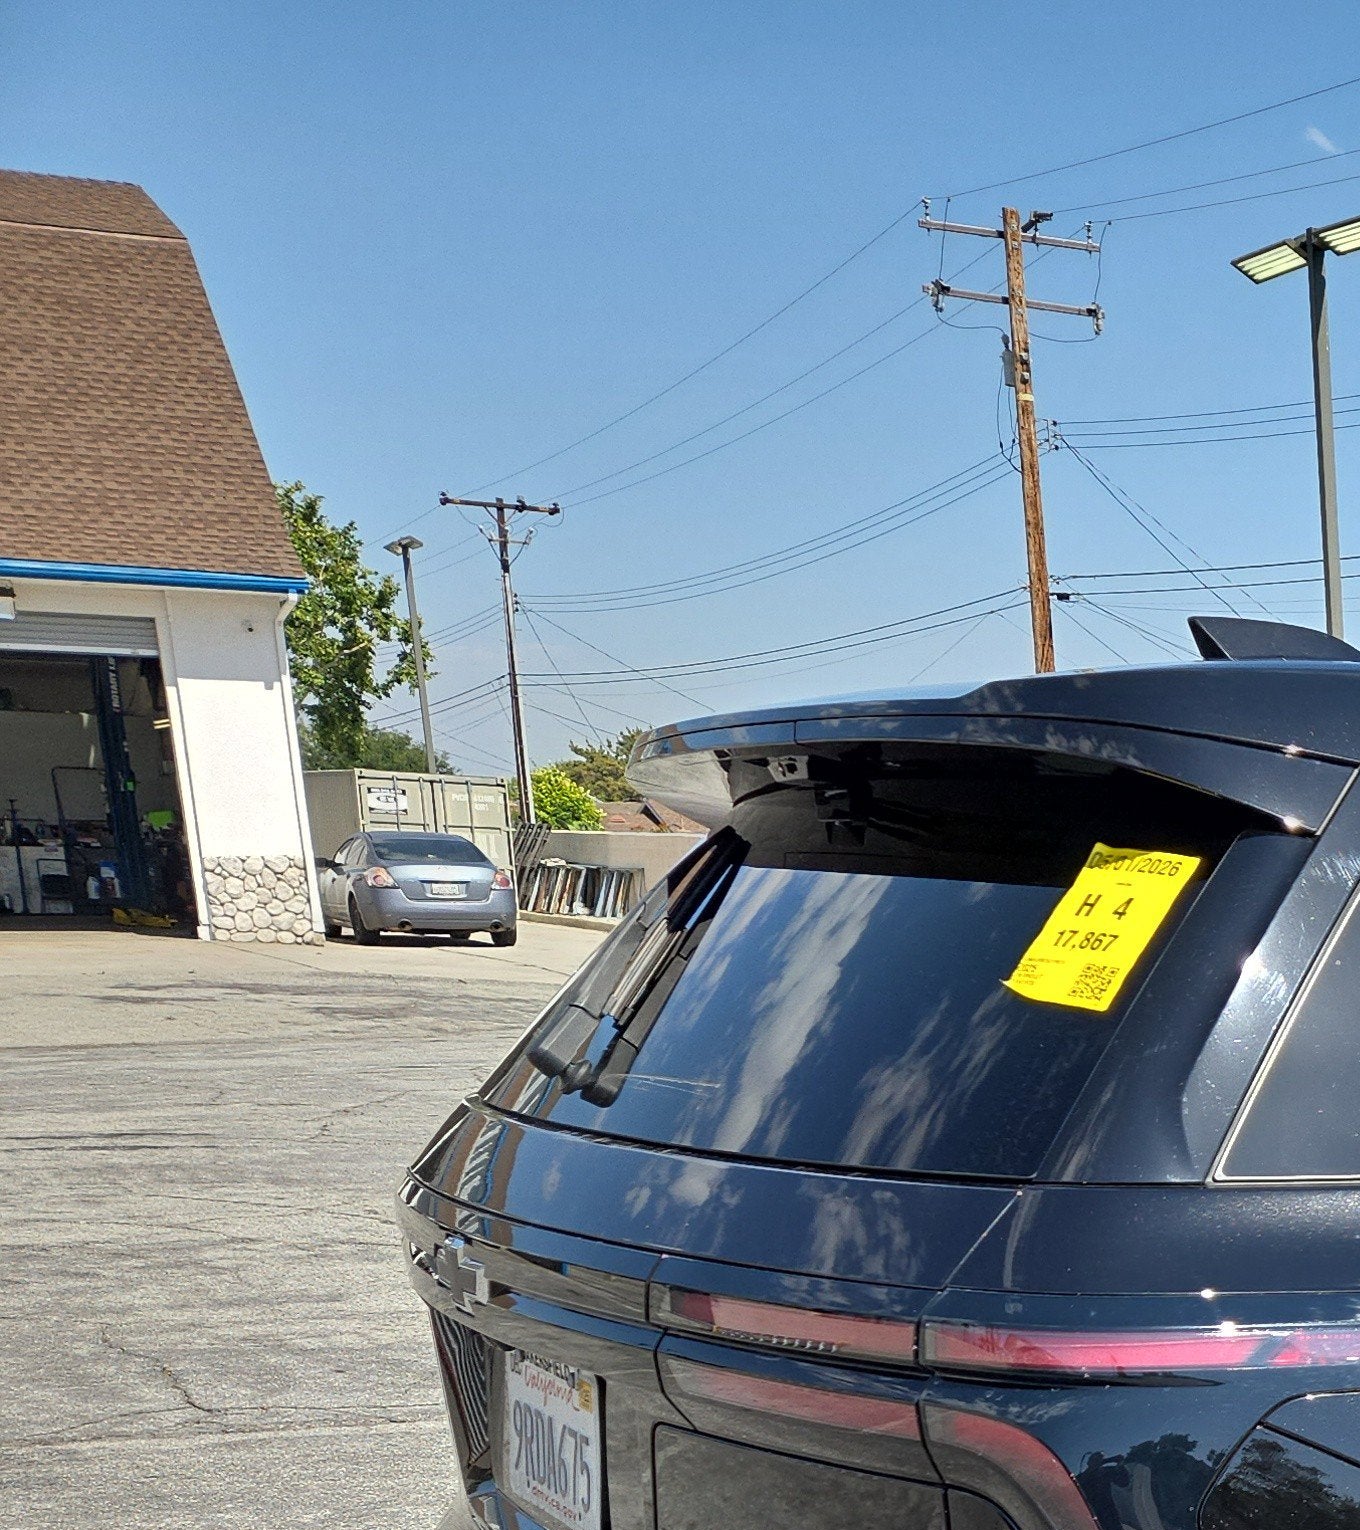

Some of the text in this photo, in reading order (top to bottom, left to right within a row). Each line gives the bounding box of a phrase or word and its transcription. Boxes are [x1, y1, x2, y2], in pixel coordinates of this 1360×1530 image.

[1074, 893, 1135, 921] H 4
[1053, 929, 1121, 953] 17,867
[513, 1399, 591, 1514] 9RDA675
